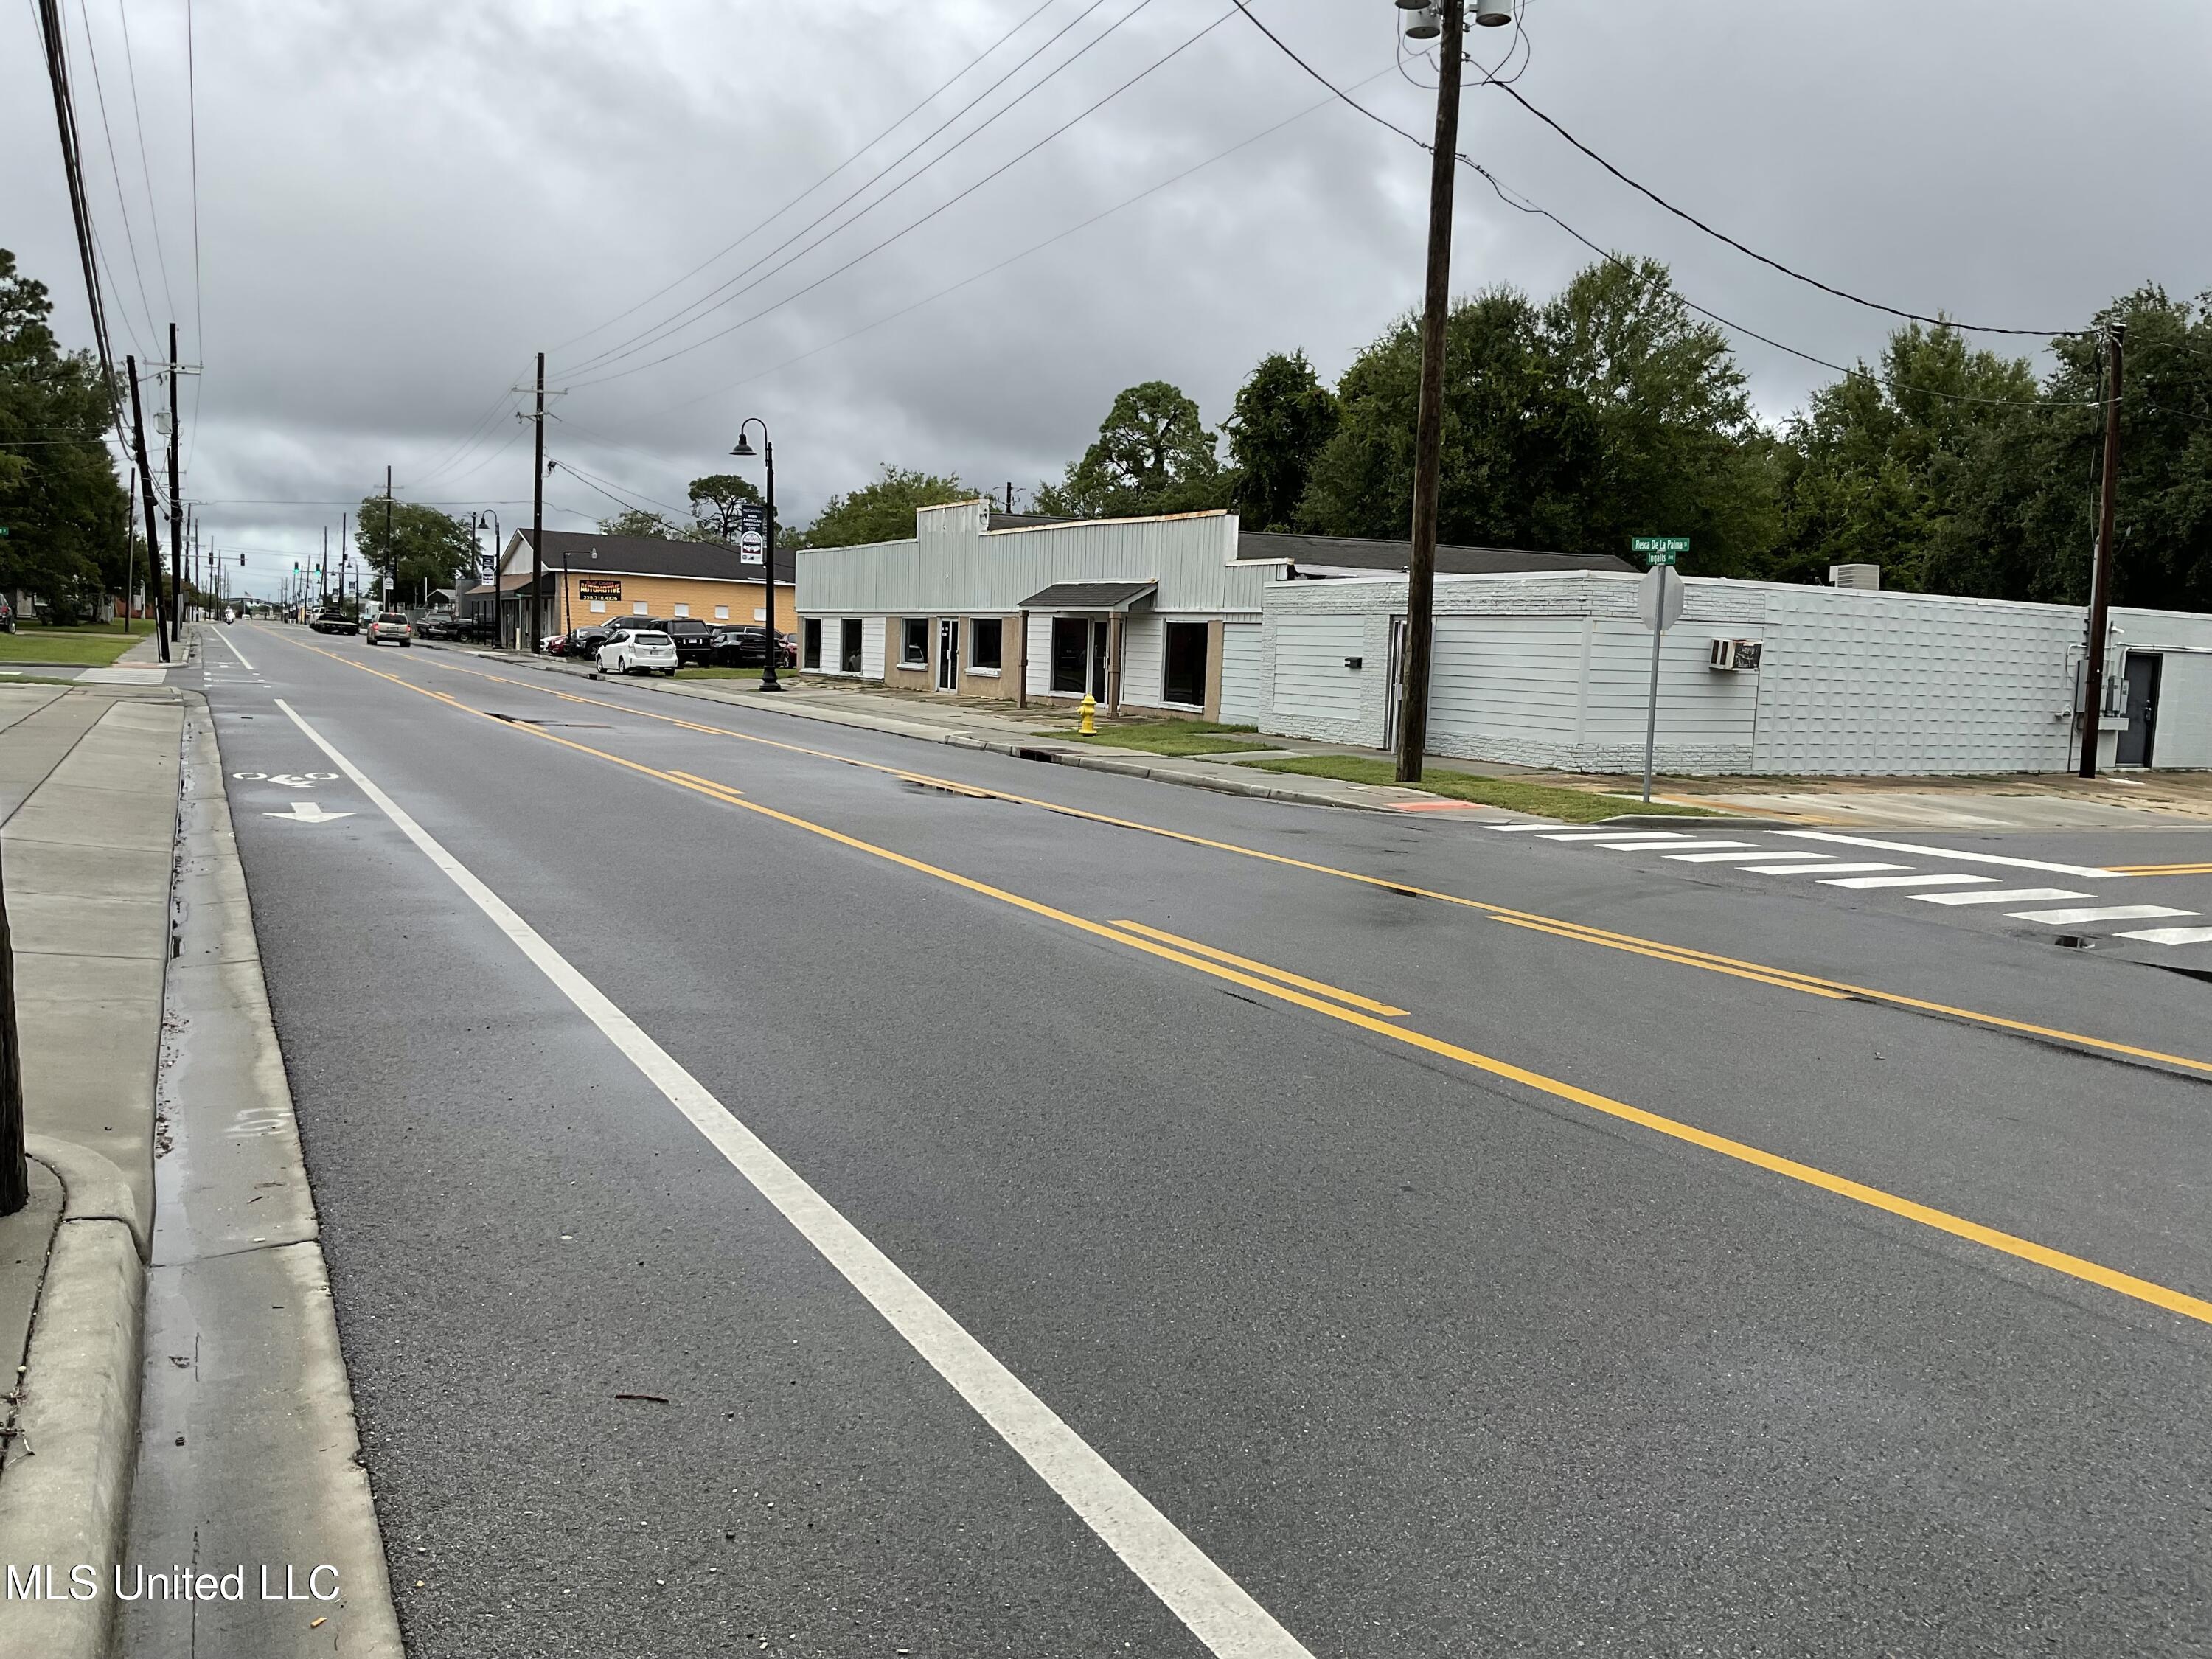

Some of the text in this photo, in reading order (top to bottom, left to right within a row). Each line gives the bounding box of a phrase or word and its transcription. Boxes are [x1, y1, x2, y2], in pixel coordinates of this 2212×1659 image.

[1635, 539, 1650, 549] Resca
[1652, 539, 1658, 549] De
[1660, 539, 1666, 549] La
[1667, 539, 1683, 549] Palma
[1648, 553, 1666, 565] Ingalls
[581, 583, 620, 593] AUTOMOTIVE
